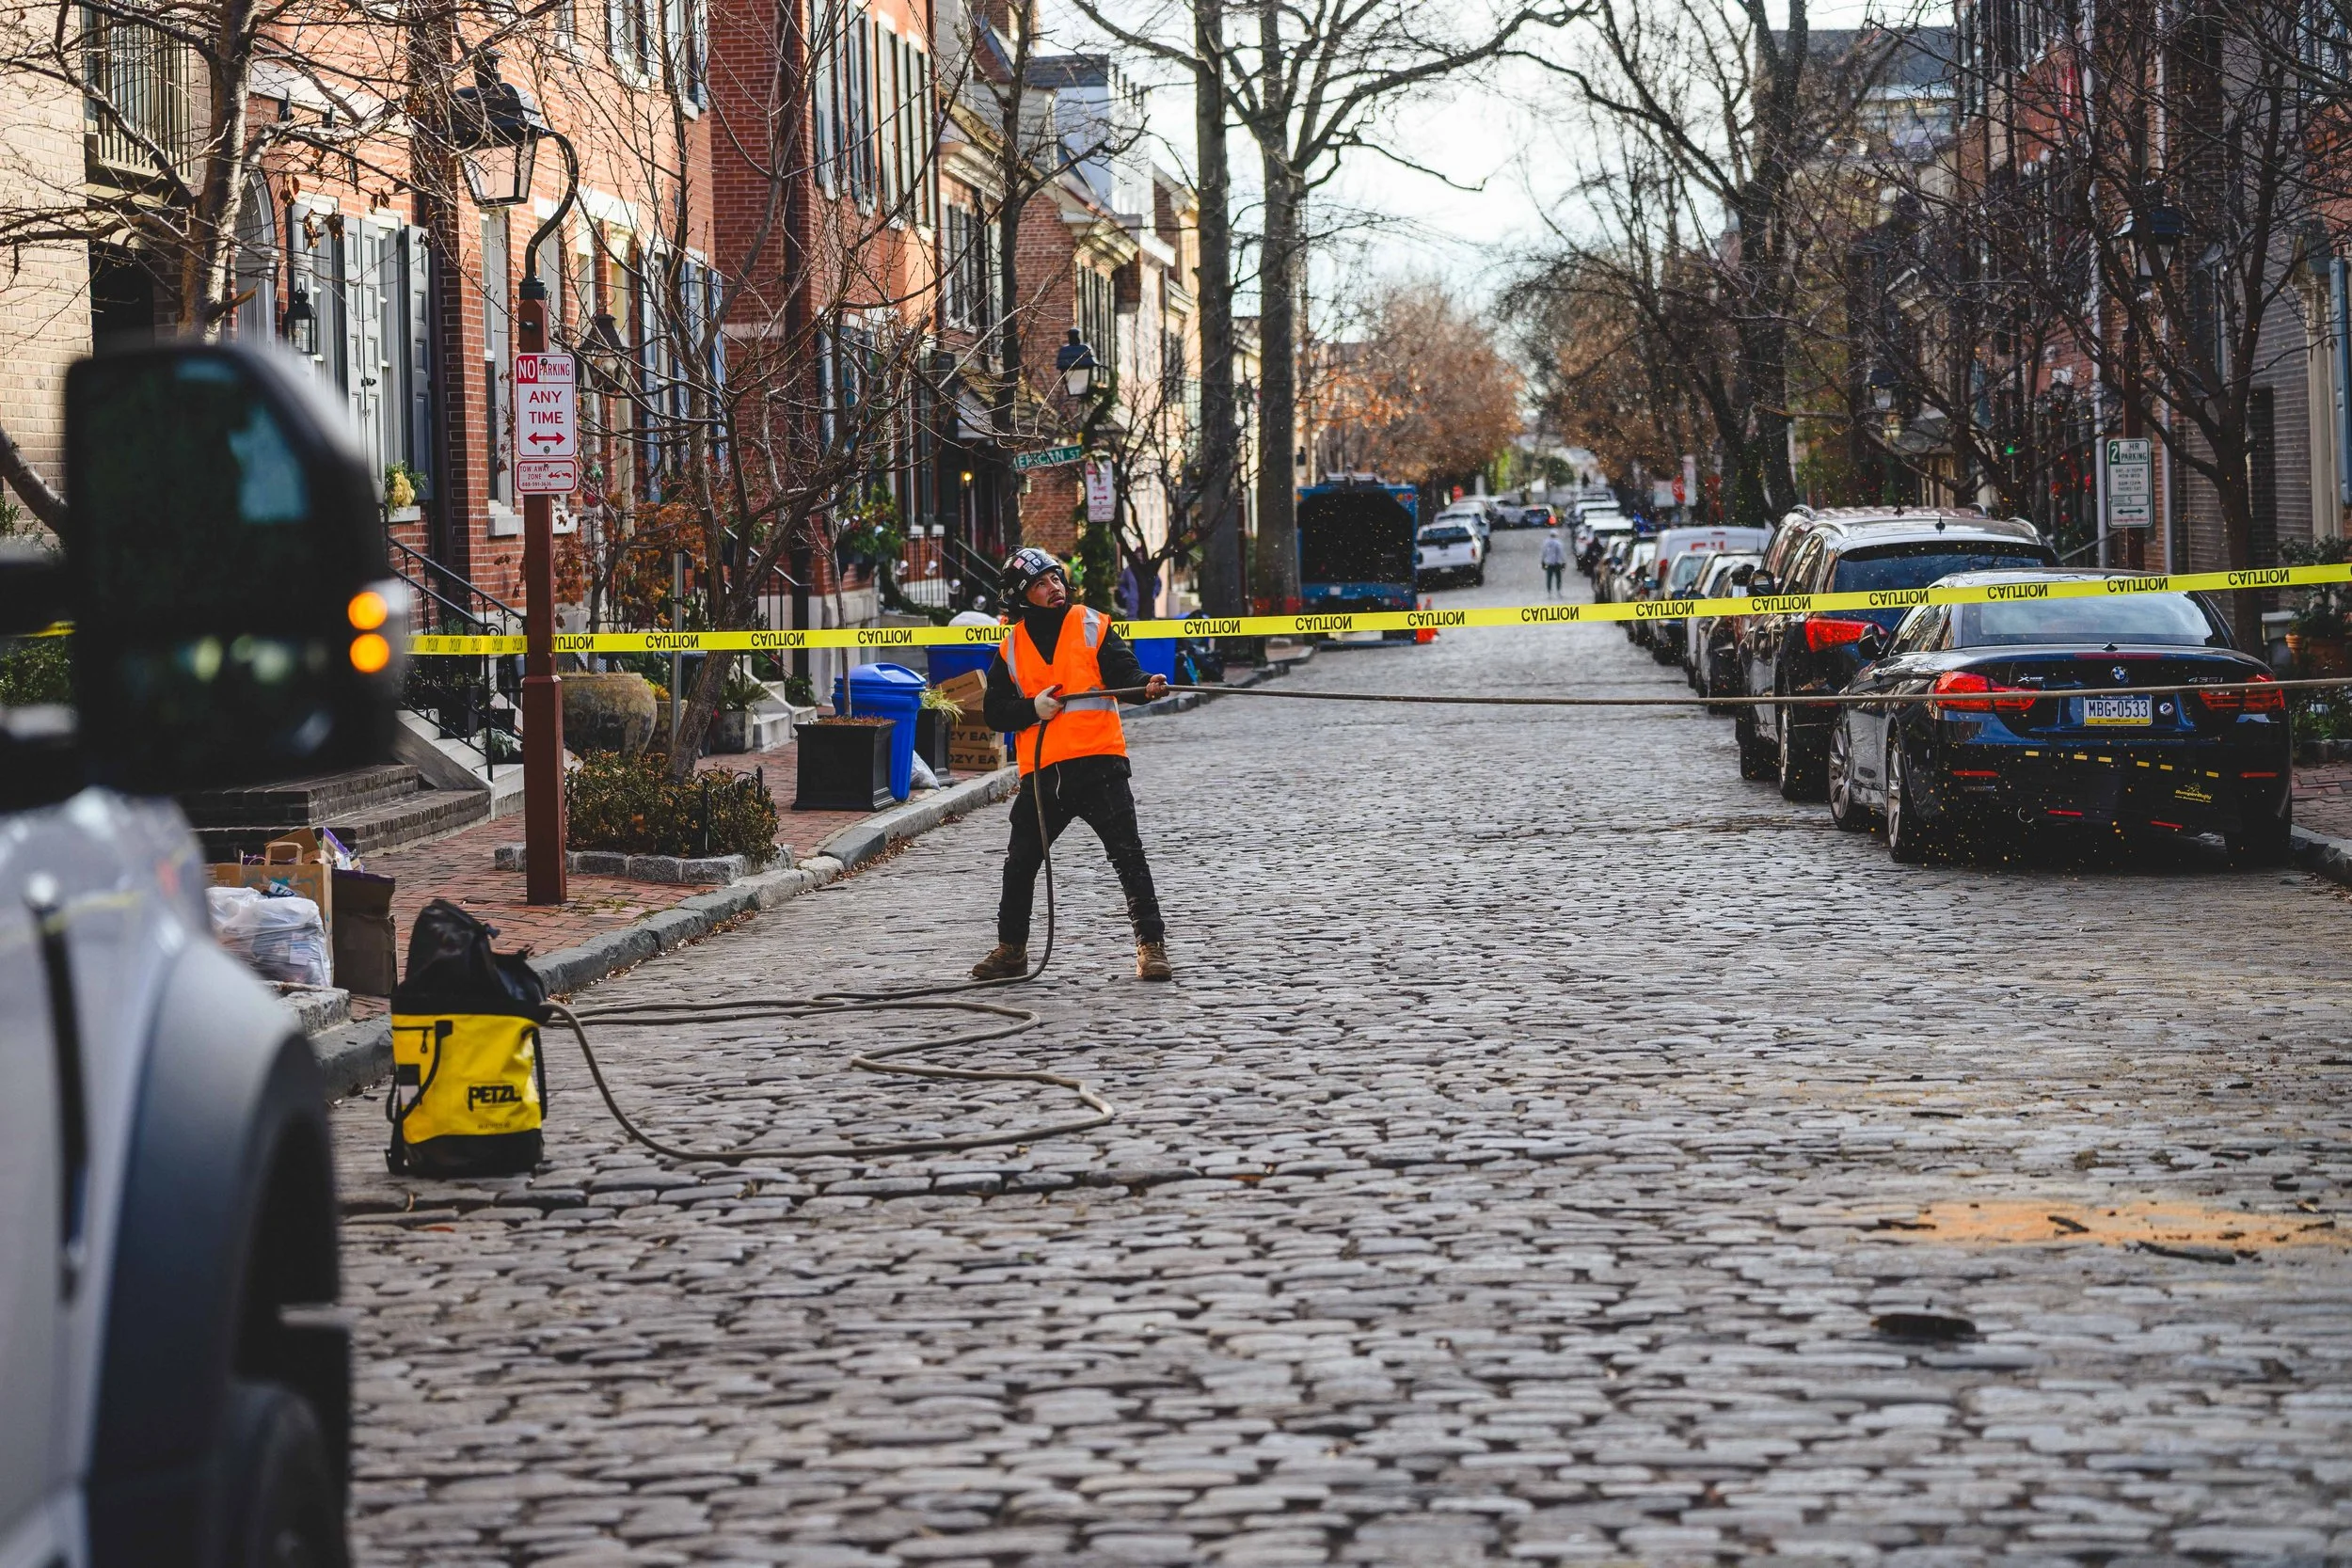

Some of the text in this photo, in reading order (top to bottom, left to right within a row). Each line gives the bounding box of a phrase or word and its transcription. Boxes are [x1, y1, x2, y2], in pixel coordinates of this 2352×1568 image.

[518, 359, 570, 379] NO PARKING
[529, 391, 563, 404] ANY
[529, 411, 564, 424] TIME
[1069, 449, 1081, 460] ST
[2110, 445, 2119, 462] 2
[2121, 452, 2147, 461] PARKING
[468, 1085, 523, 1112] PETZL
